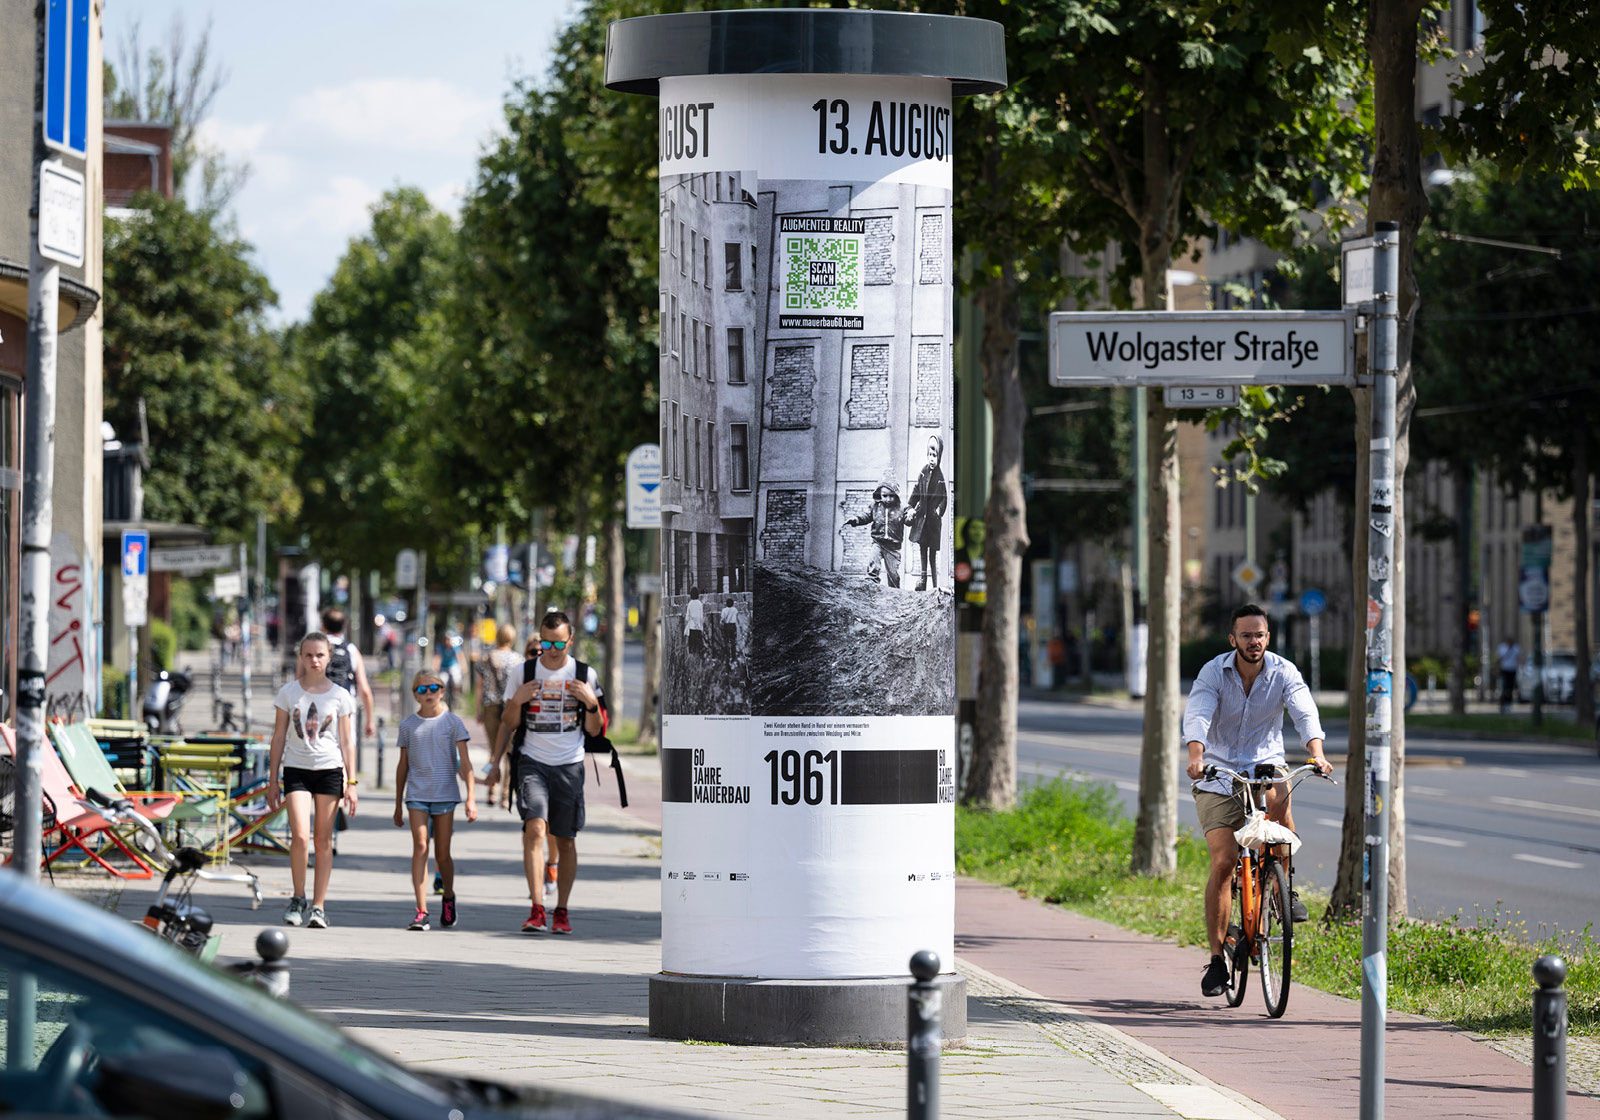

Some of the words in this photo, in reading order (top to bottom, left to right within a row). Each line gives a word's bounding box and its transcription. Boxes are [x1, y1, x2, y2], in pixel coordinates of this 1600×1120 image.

[812, 99, 857, 154] 13.
[865, 101, 950, 162] AUGUST
[782, 218, 831, 231] AUGMENTED
[833, 219, 864, 232] REALITY
[811, 262, 834, 274] SCAN
[811, 274, 835, 286] MICH
[781, 317, 862, 328] www.mauerbau60.berlin
[1086, 331, 1226, 369] Wolgaster
[1234, 331, 1319, 369] Straße
[1180, 389, 1194, 400] 13
[1216, 389, 1225, 400] 8
[693, 749, 704, 766] 60
[694, 767, 722, 785] JAHRE
[763, 750, 838, 806] 1961
[694, 786, 750, 804] MAUERBAU
